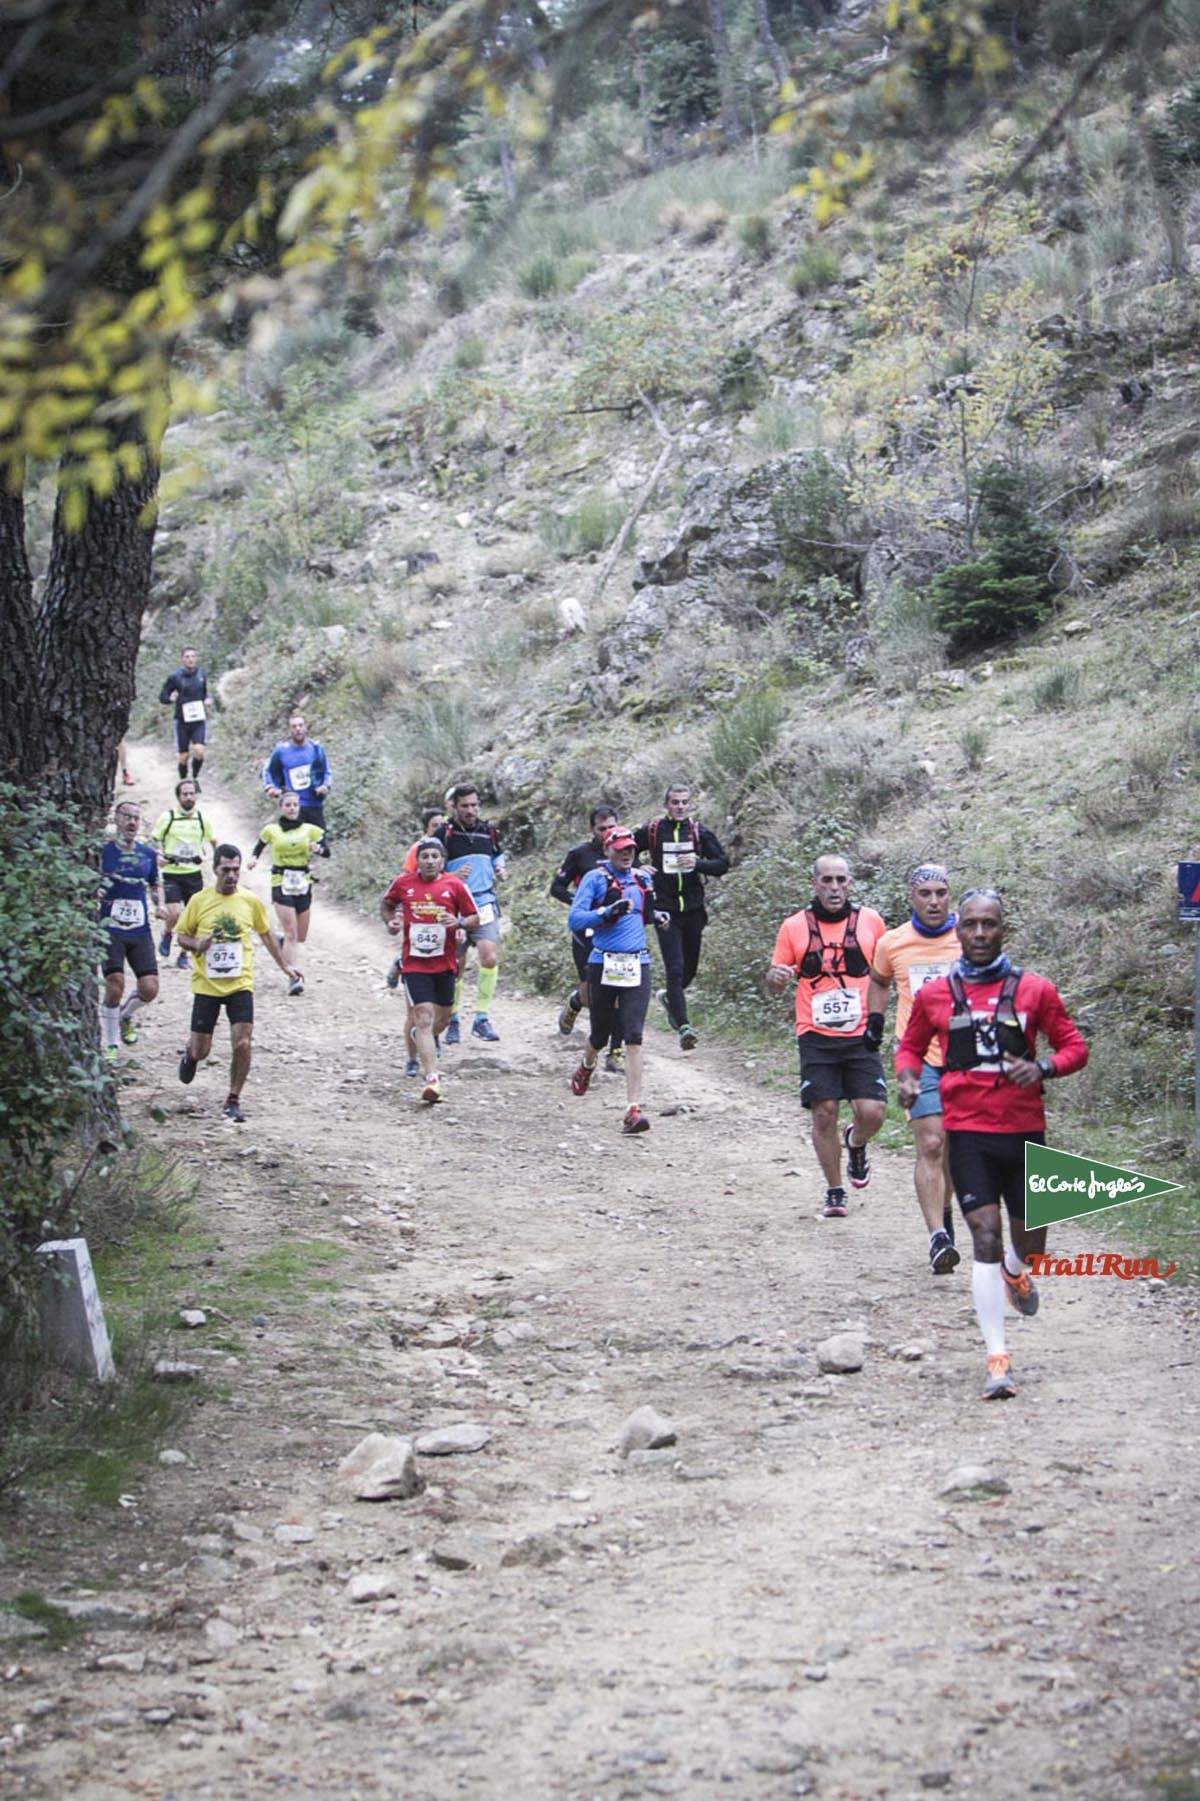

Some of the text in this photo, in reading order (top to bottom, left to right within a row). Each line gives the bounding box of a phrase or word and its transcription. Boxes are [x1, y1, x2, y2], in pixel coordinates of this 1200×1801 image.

[119, 906, 137, 917] 751
[417, 933, 438, 943] 842
[213, 952, 236, 961] 974
[823, 1001, 849, 1014] 557
